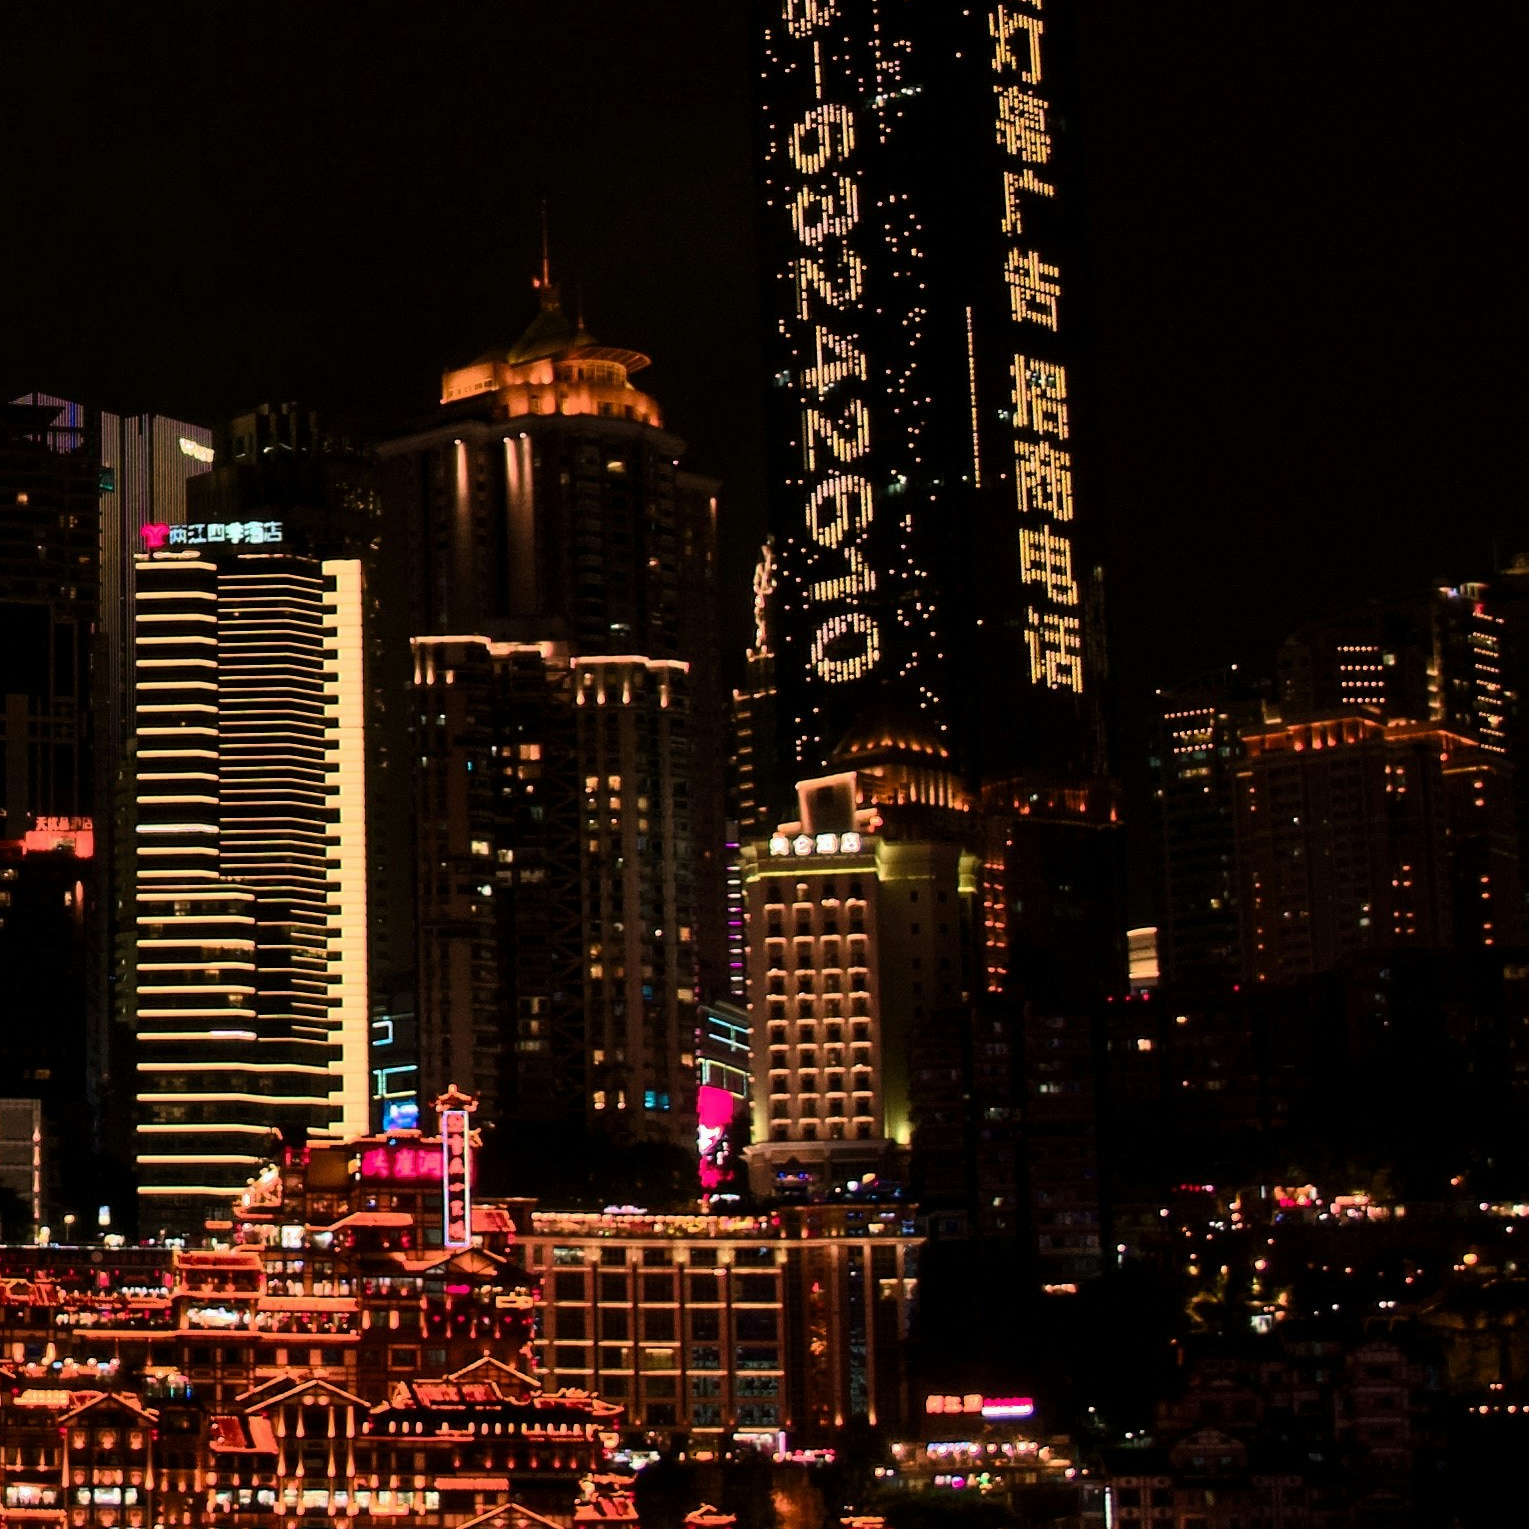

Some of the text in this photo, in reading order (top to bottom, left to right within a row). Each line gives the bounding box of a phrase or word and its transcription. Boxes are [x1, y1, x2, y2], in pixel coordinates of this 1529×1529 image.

[168, 521, 283, 544] 两江四季酒店
